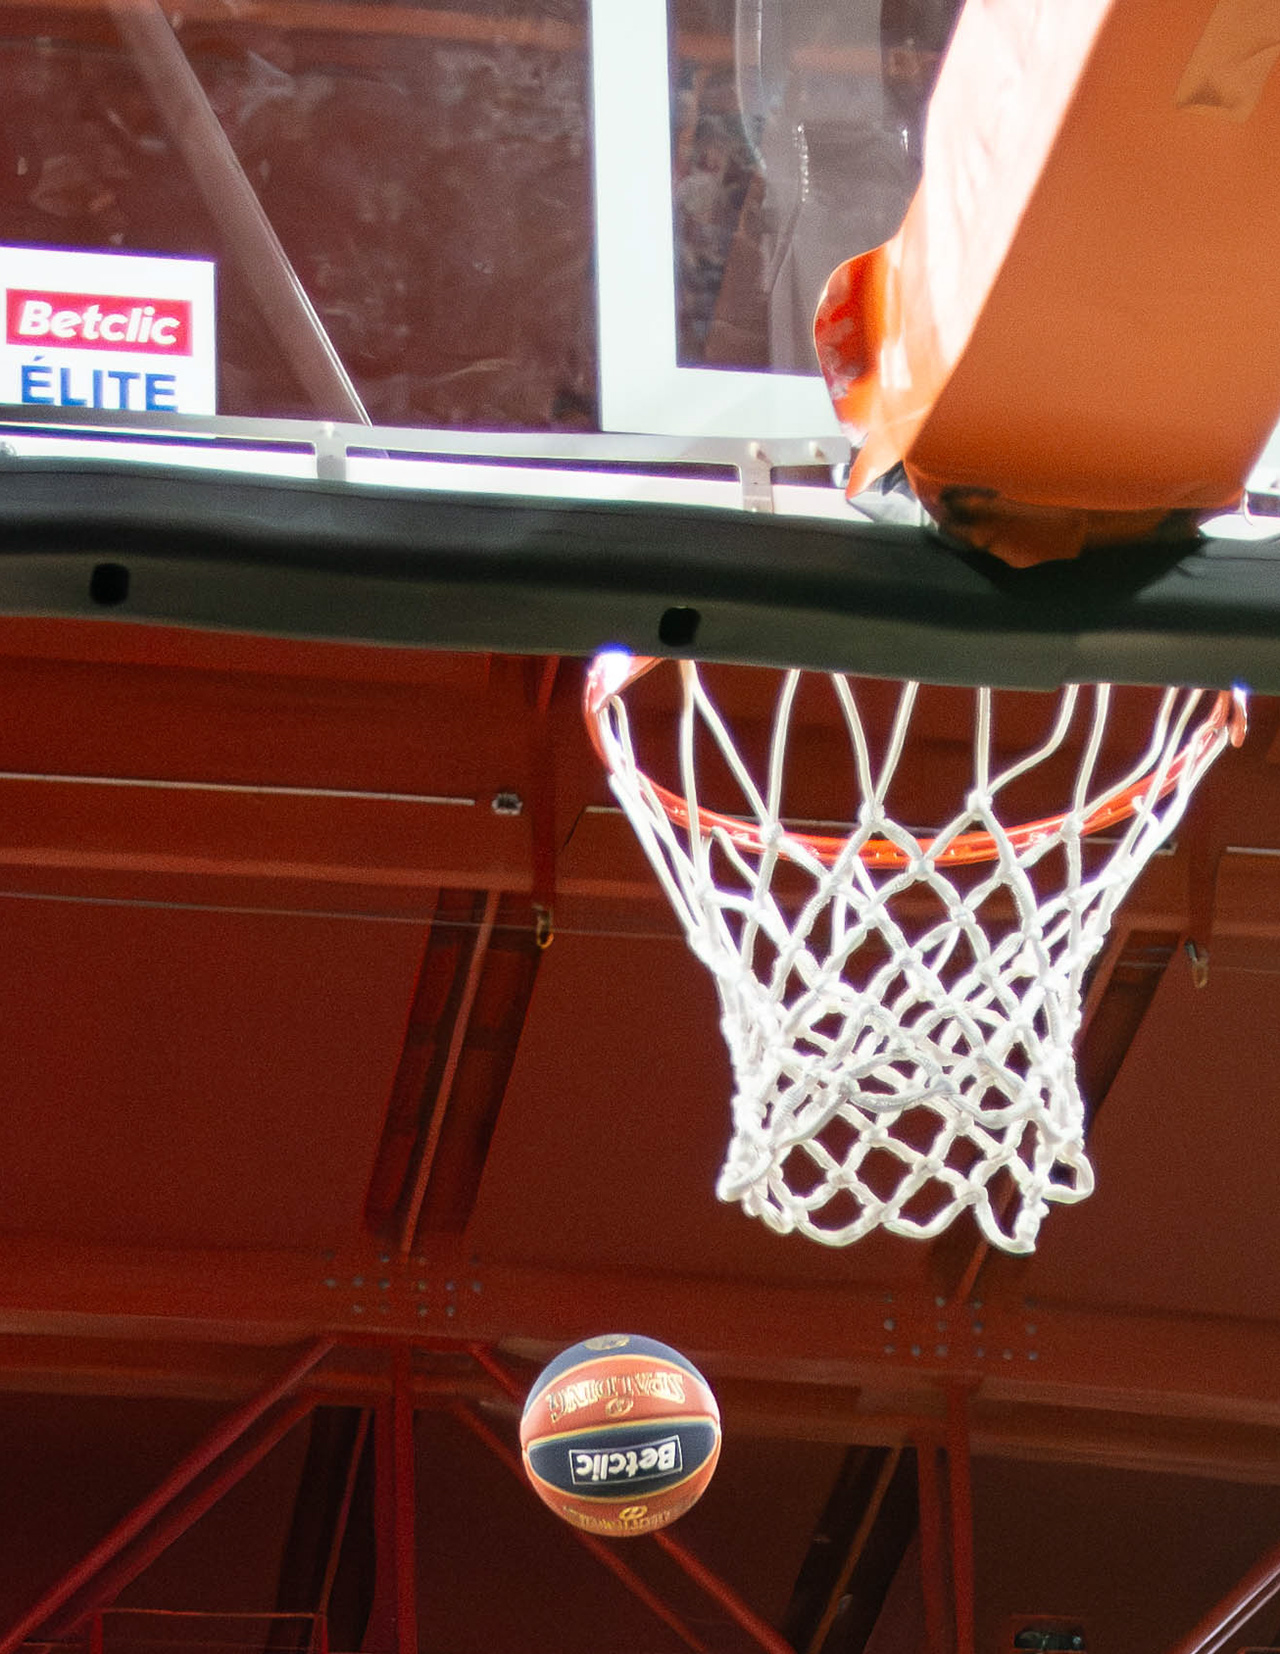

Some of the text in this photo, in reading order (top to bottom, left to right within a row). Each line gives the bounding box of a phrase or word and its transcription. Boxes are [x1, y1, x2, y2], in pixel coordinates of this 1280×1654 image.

[19, 300, 179, 345] Betclic
[21, 356, 178, 413] ÉLITE
[576, 1441, 676, 1482] Betclic
